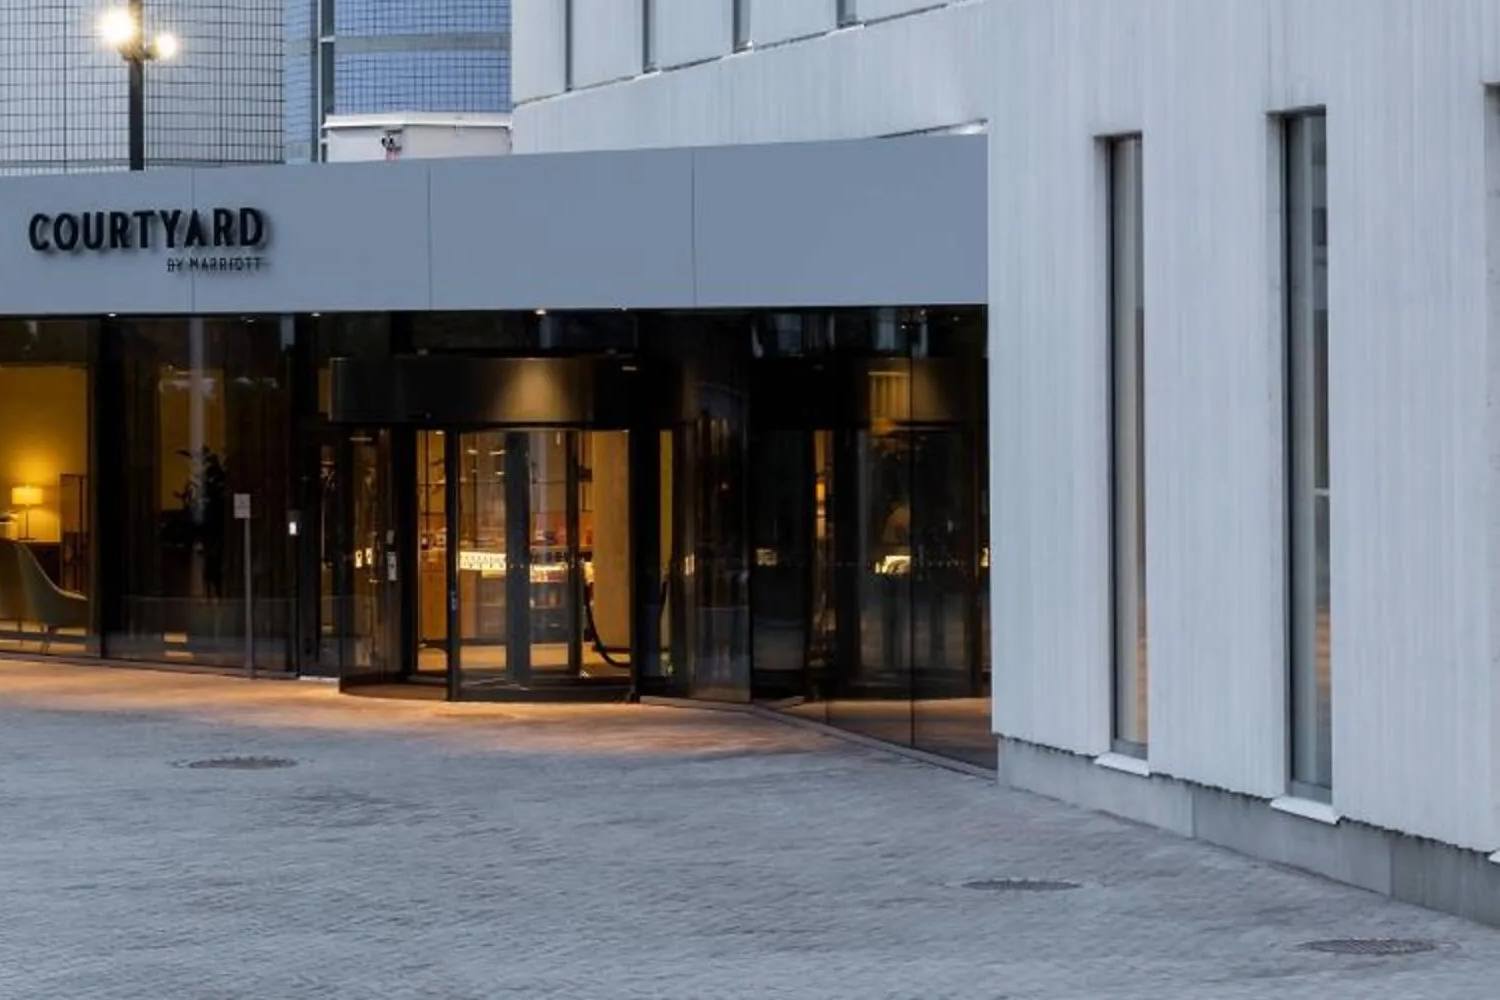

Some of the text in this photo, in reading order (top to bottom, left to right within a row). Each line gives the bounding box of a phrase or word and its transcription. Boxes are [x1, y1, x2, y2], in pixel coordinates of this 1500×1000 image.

[28, 207, 265, 251] COURTYARD
[167, 257, 262, 272] BY MARRIOTT
